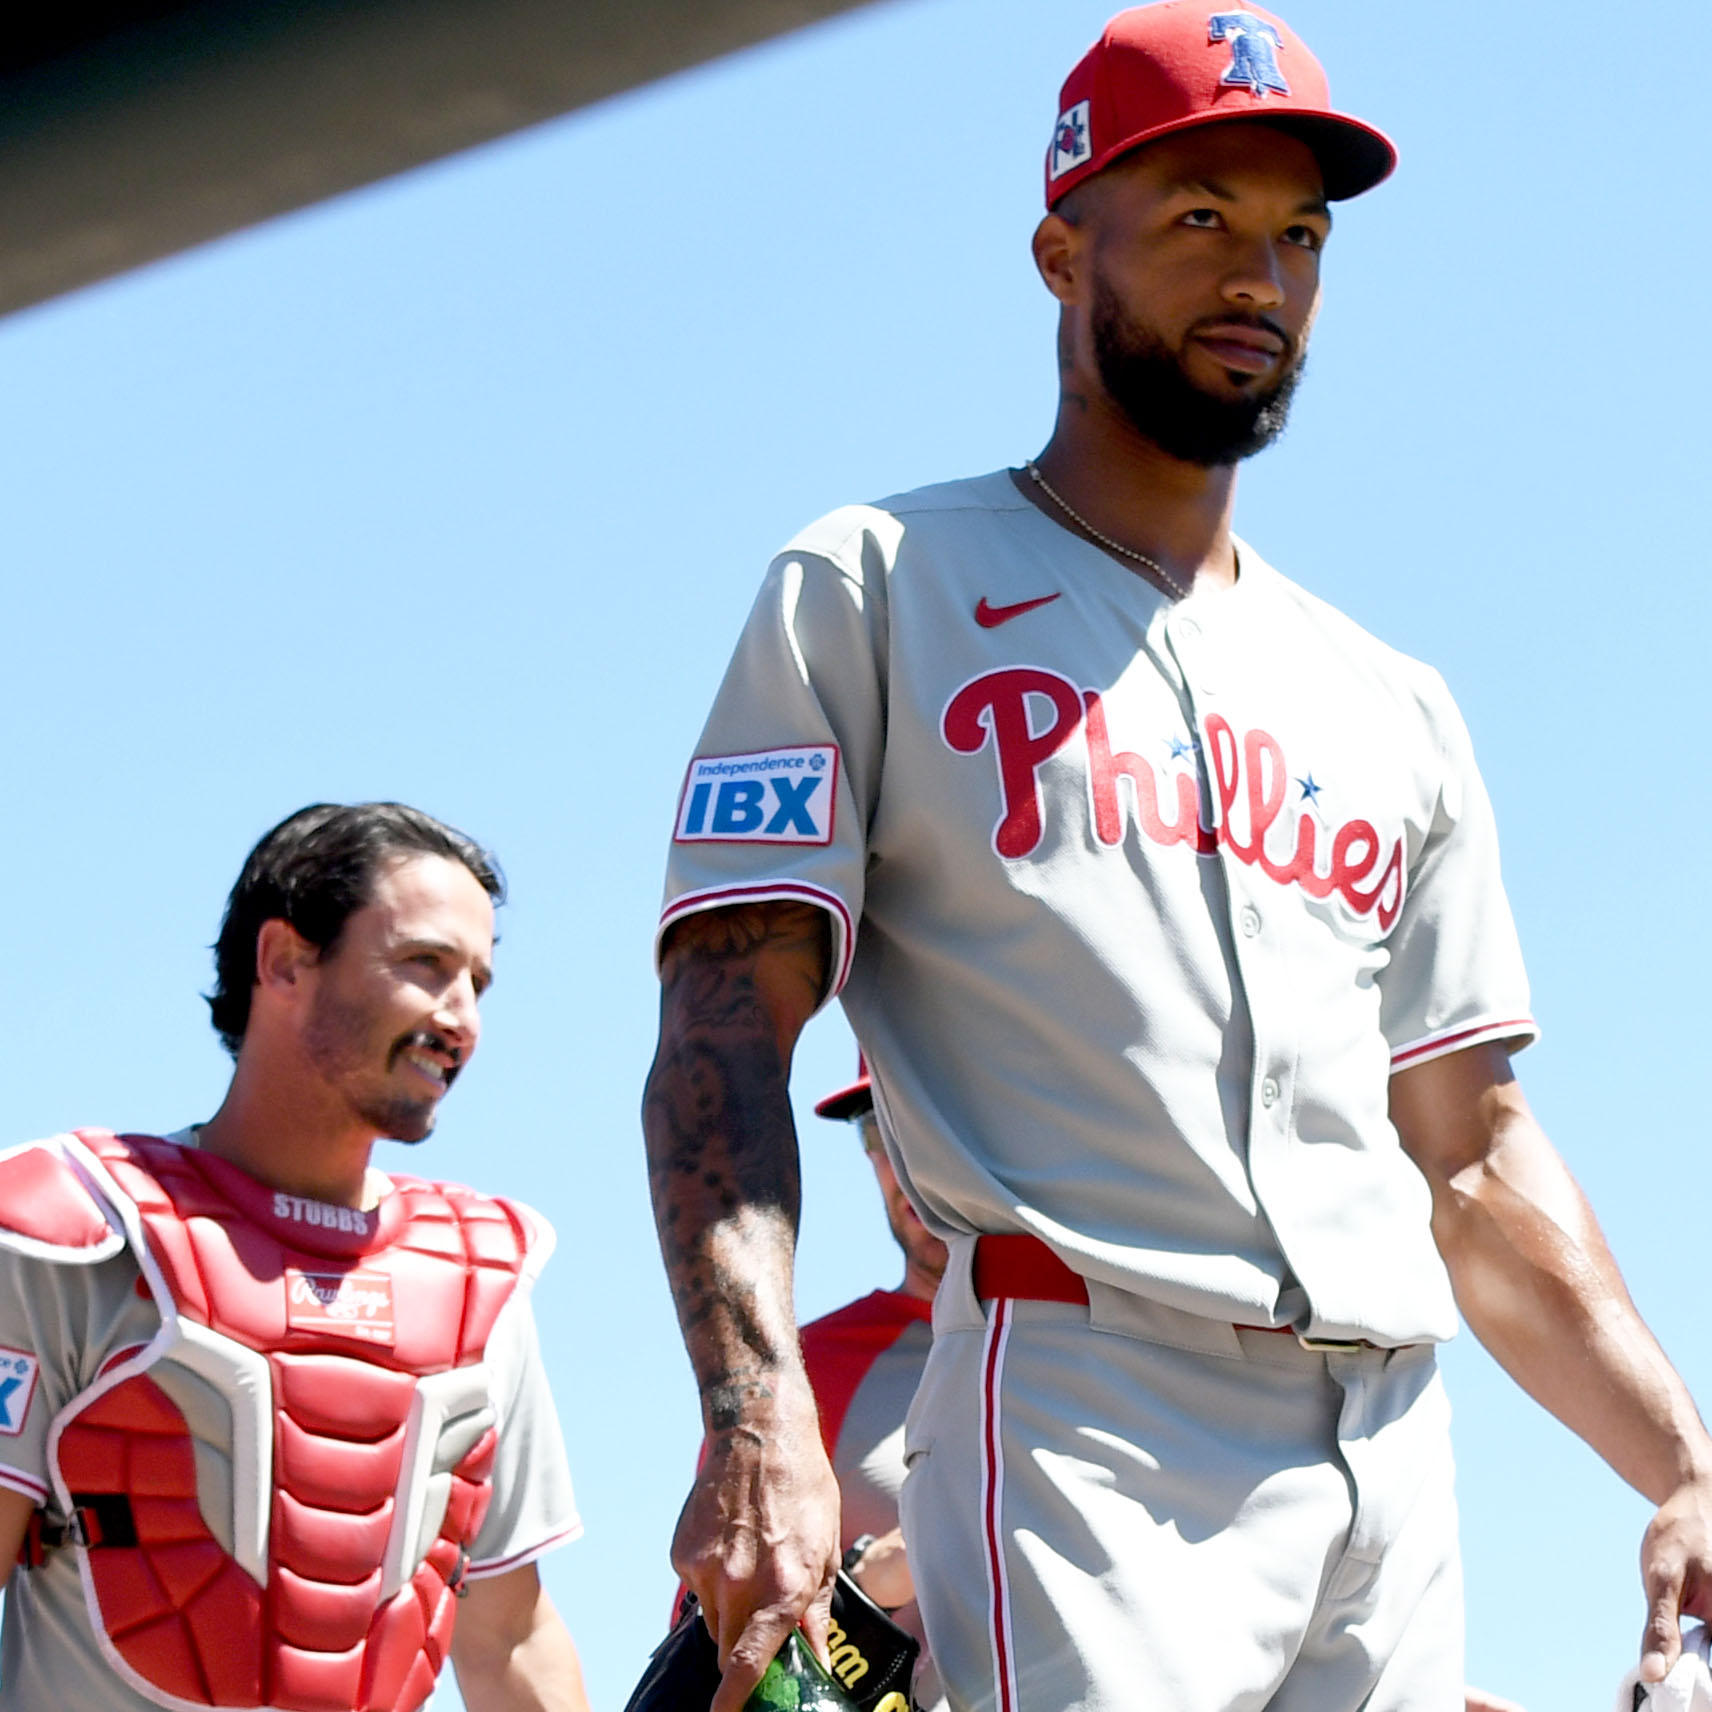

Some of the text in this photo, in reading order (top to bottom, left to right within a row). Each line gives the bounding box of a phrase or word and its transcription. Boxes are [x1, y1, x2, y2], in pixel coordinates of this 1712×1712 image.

[697, 757, 805, 777] Independence
[685, 776, 823, 836] IBX
[940, 664, 1408, 934] Phillies
[274, 1192, 368, 1235] STUBBS
